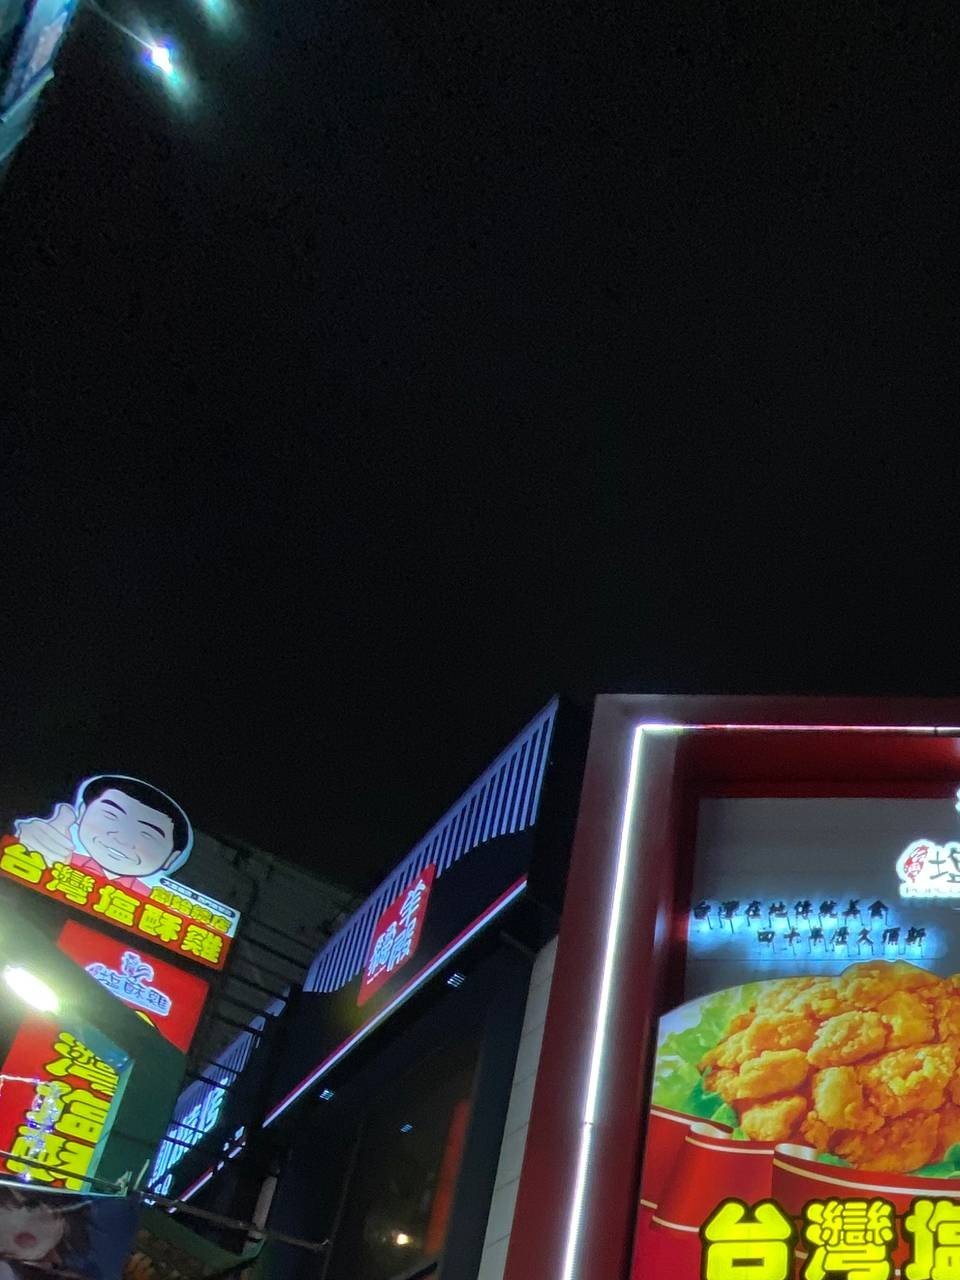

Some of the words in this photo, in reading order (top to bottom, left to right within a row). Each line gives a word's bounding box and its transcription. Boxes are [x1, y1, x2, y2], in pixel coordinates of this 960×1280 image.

[1, 843, 224, 964] 台灣塩酥雞
